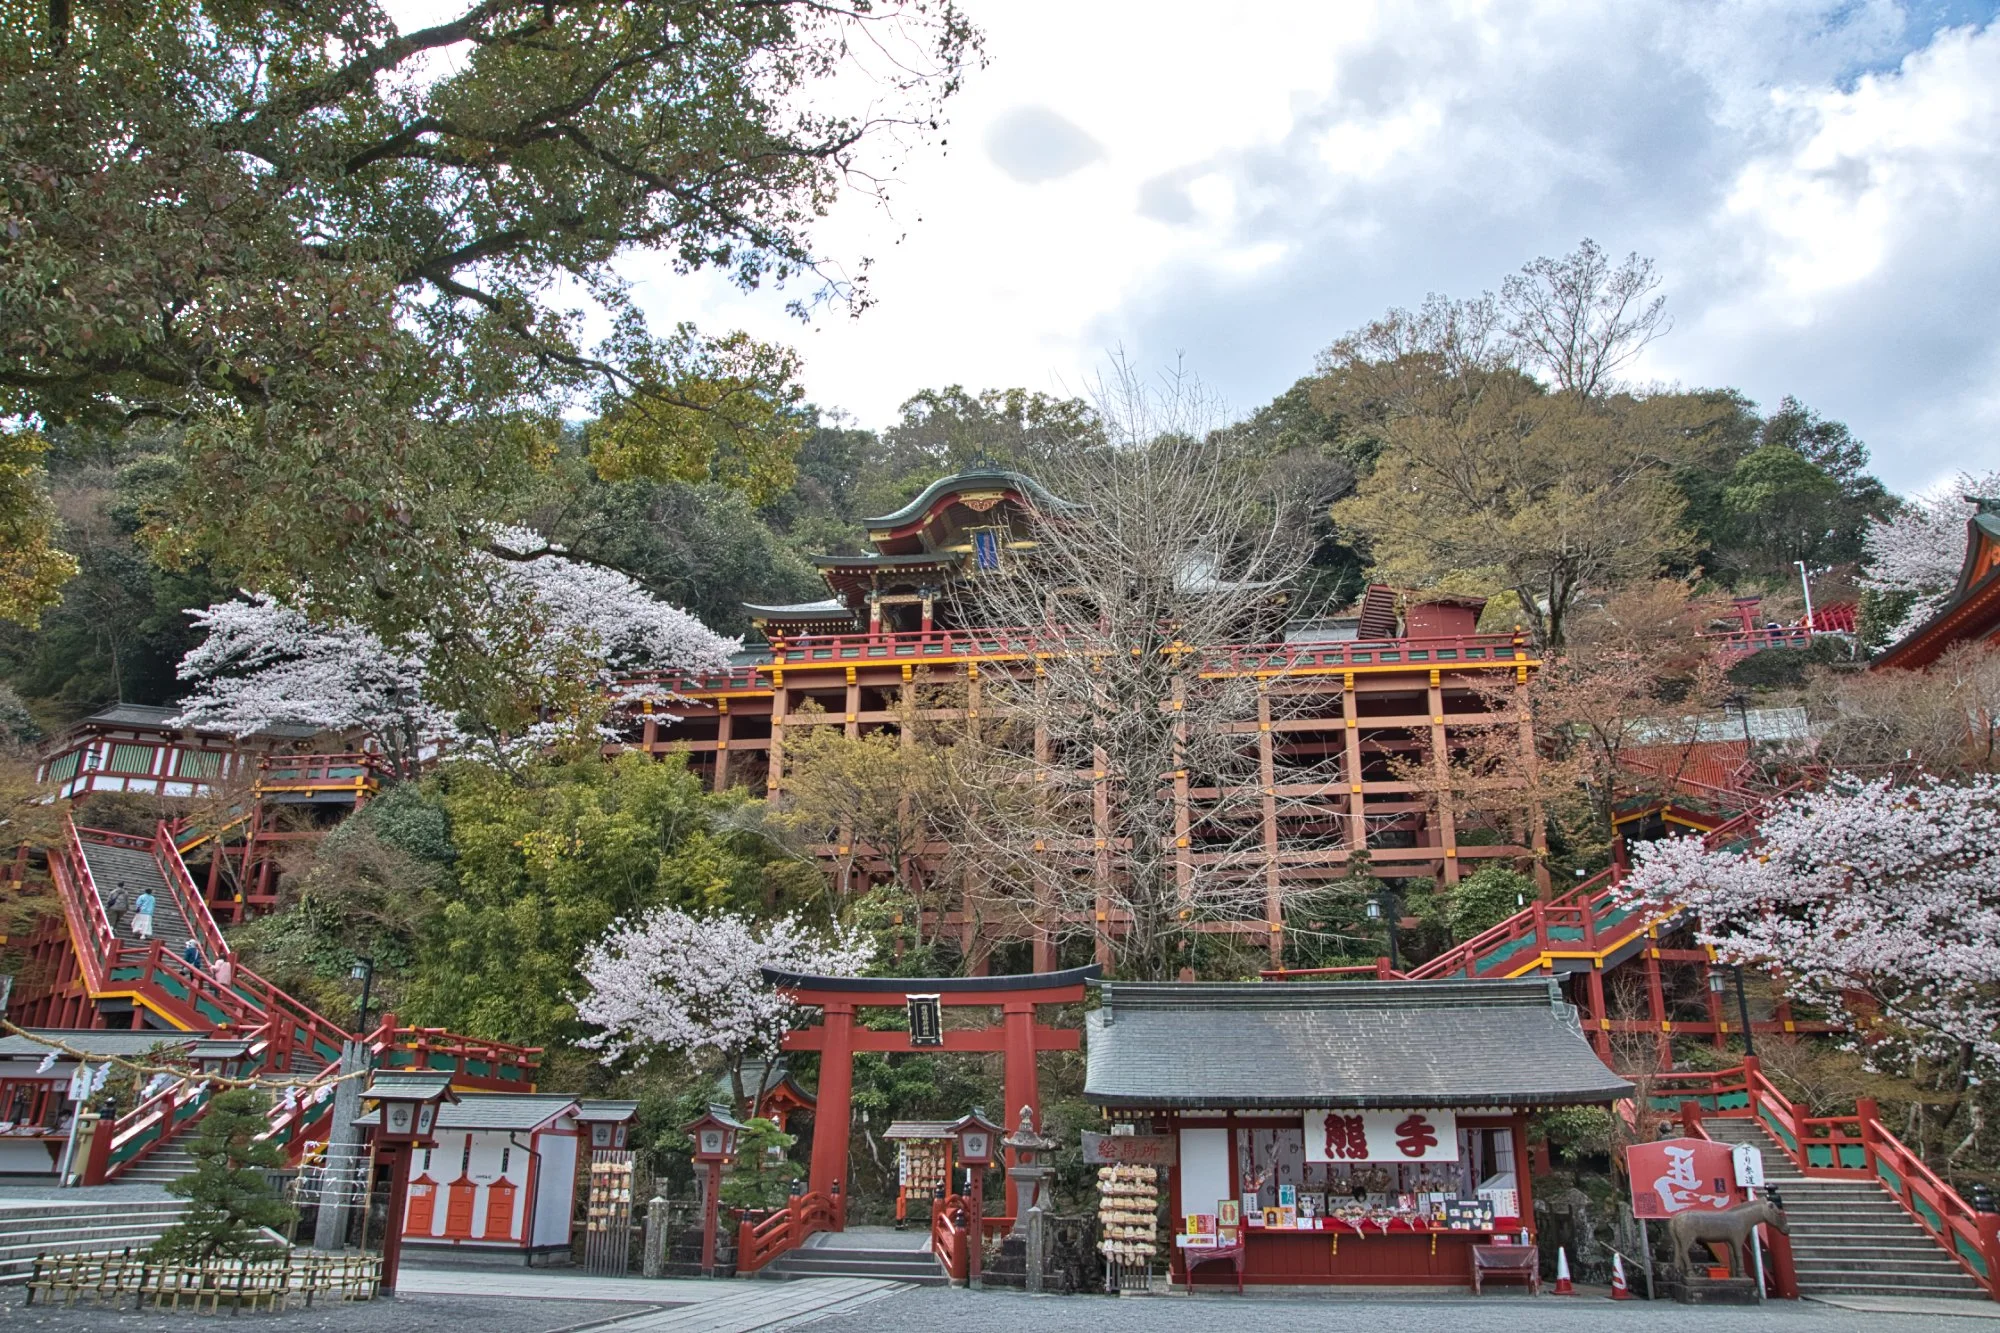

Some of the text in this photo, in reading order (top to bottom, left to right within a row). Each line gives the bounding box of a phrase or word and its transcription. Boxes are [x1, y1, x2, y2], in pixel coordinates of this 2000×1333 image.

[1098, 1140, 1160, 1160] 絵馬所
[1324, 1113, 1438, 1159] 熊手
[1742, 1146, 1756, 1185] 下り参道
